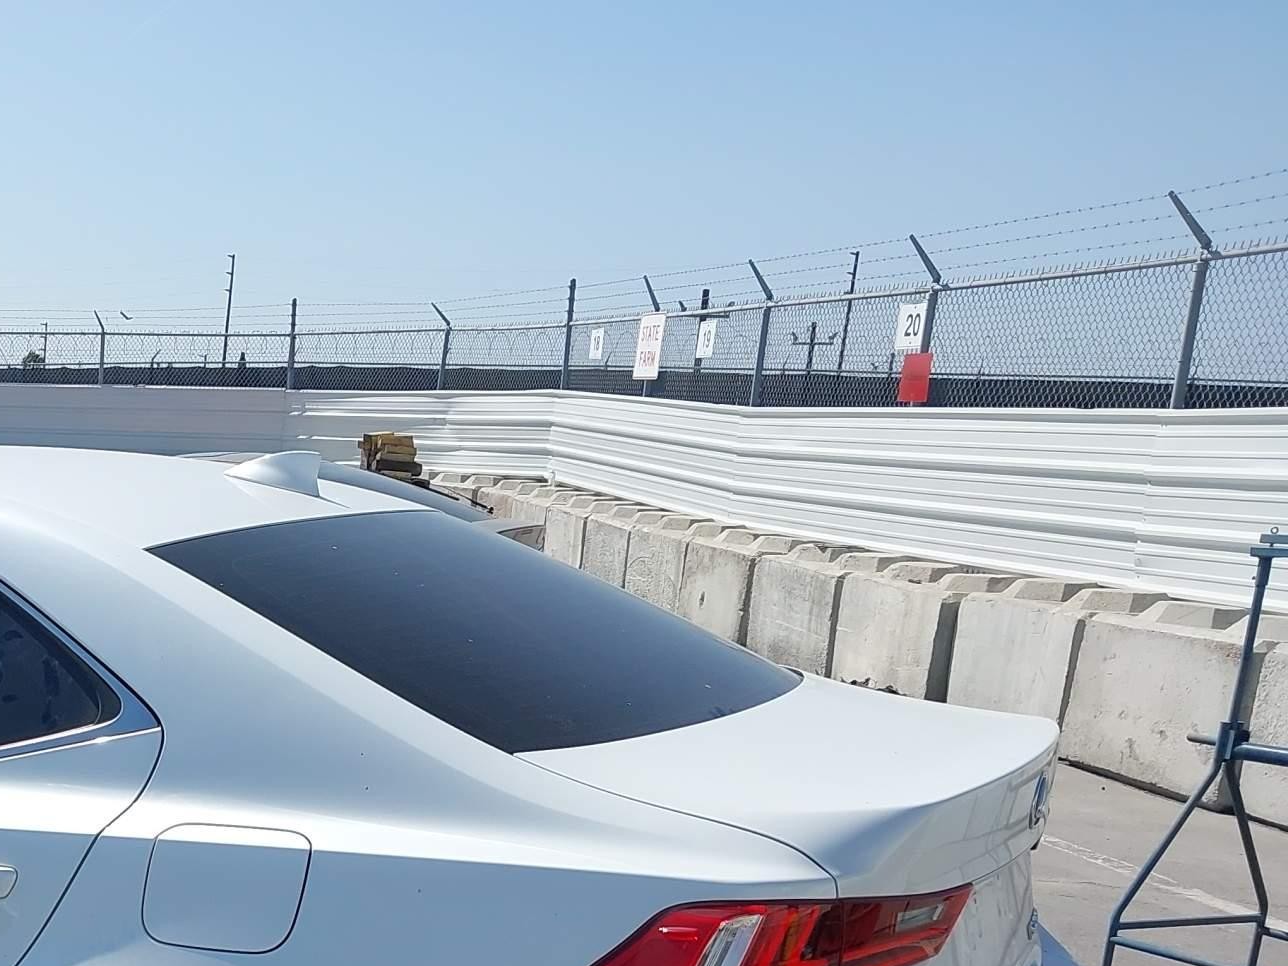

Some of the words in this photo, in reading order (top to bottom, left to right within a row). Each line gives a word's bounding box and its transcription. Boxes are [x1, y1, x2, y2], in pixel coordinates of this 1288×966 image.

[641, 324, 661, 342] STATE
[904, 312, 921, 337] 20
[702, 329, 712, 351] 19
[638, 350, 656, 368] FARM
